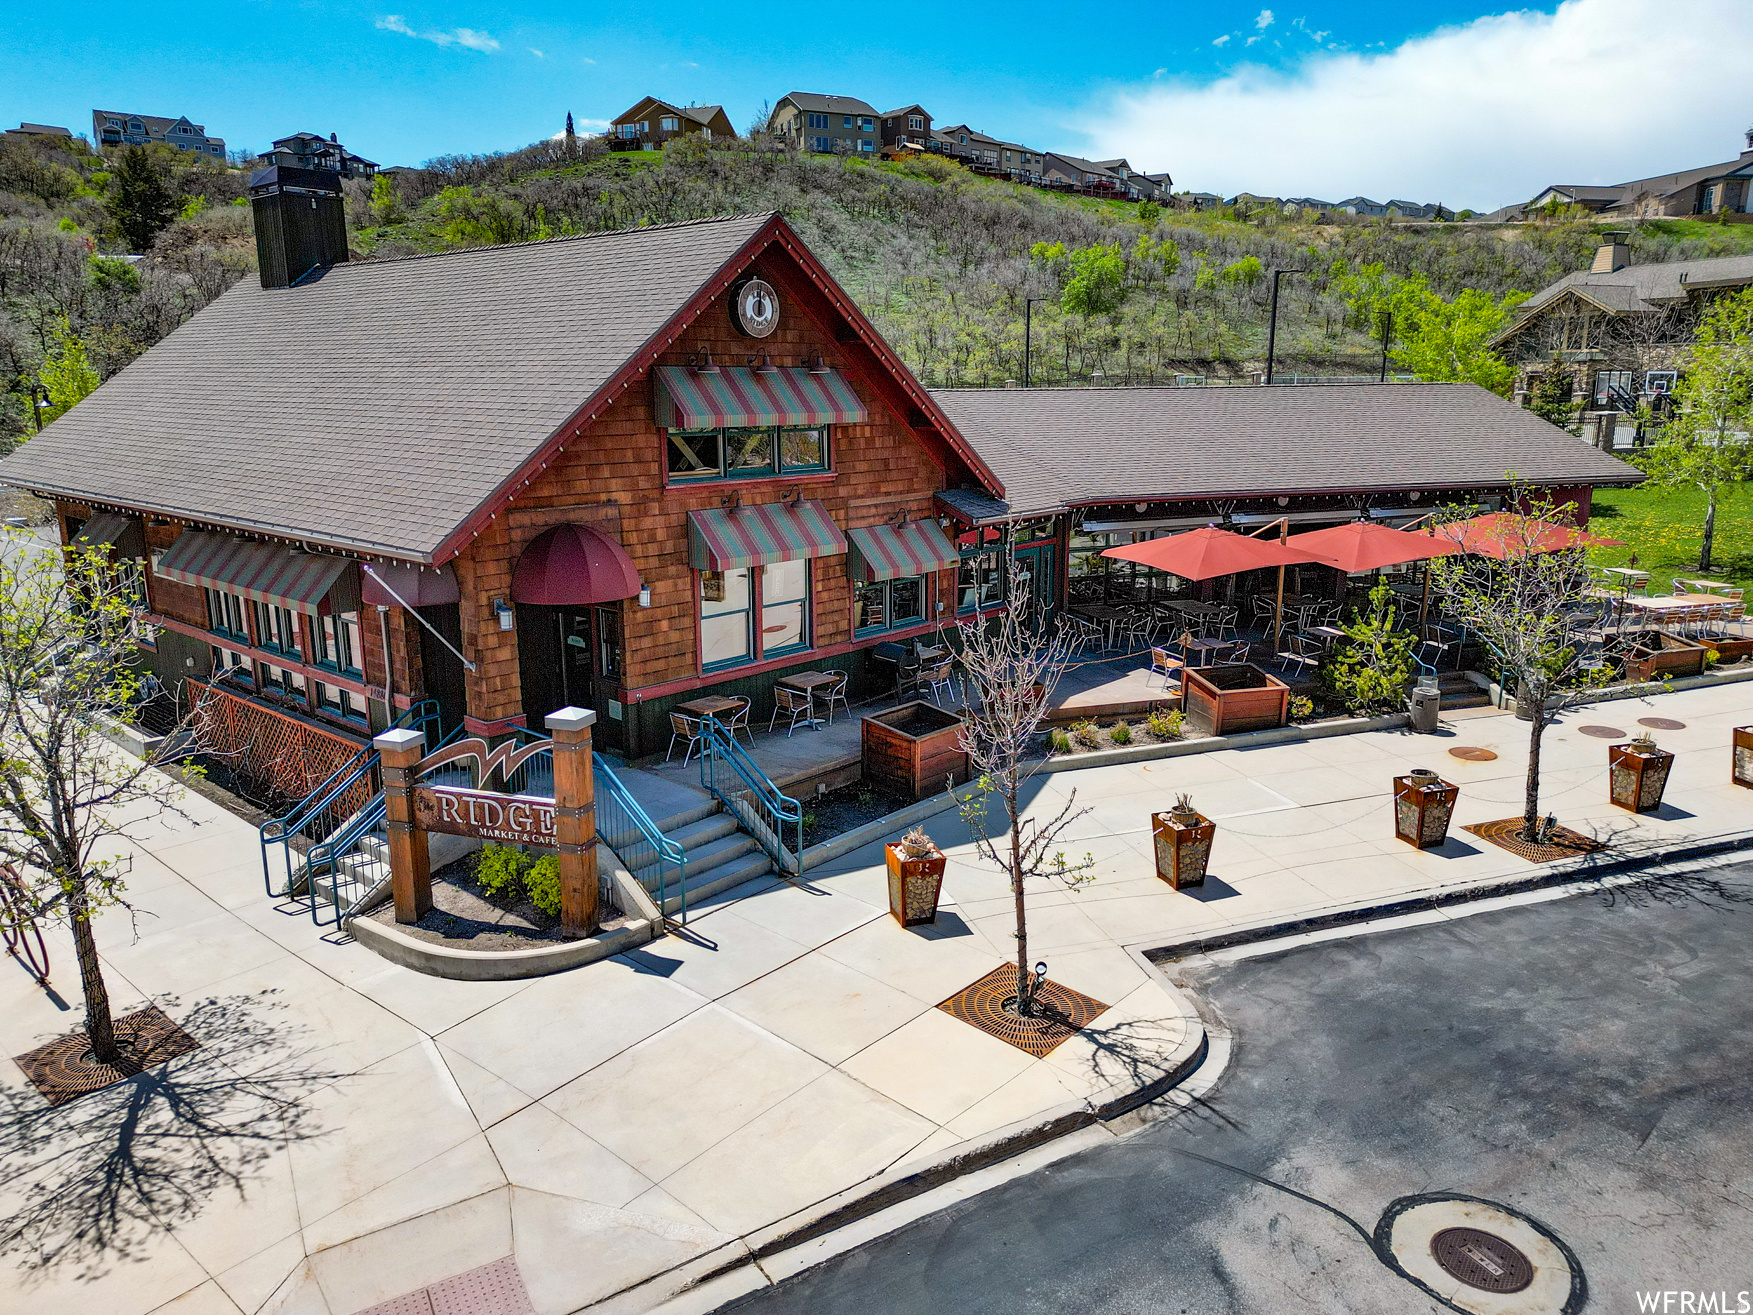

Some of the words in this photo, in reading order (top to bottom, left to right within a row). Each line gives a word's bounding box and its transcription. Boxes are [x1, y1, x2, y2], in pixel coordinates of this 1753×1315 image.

[436, 793, 558, 836] RIDGE
[479, 827, 519, 840] MARKET
[522, 833, 530, 842] &
[532, 834, 557, 845] CAFE
